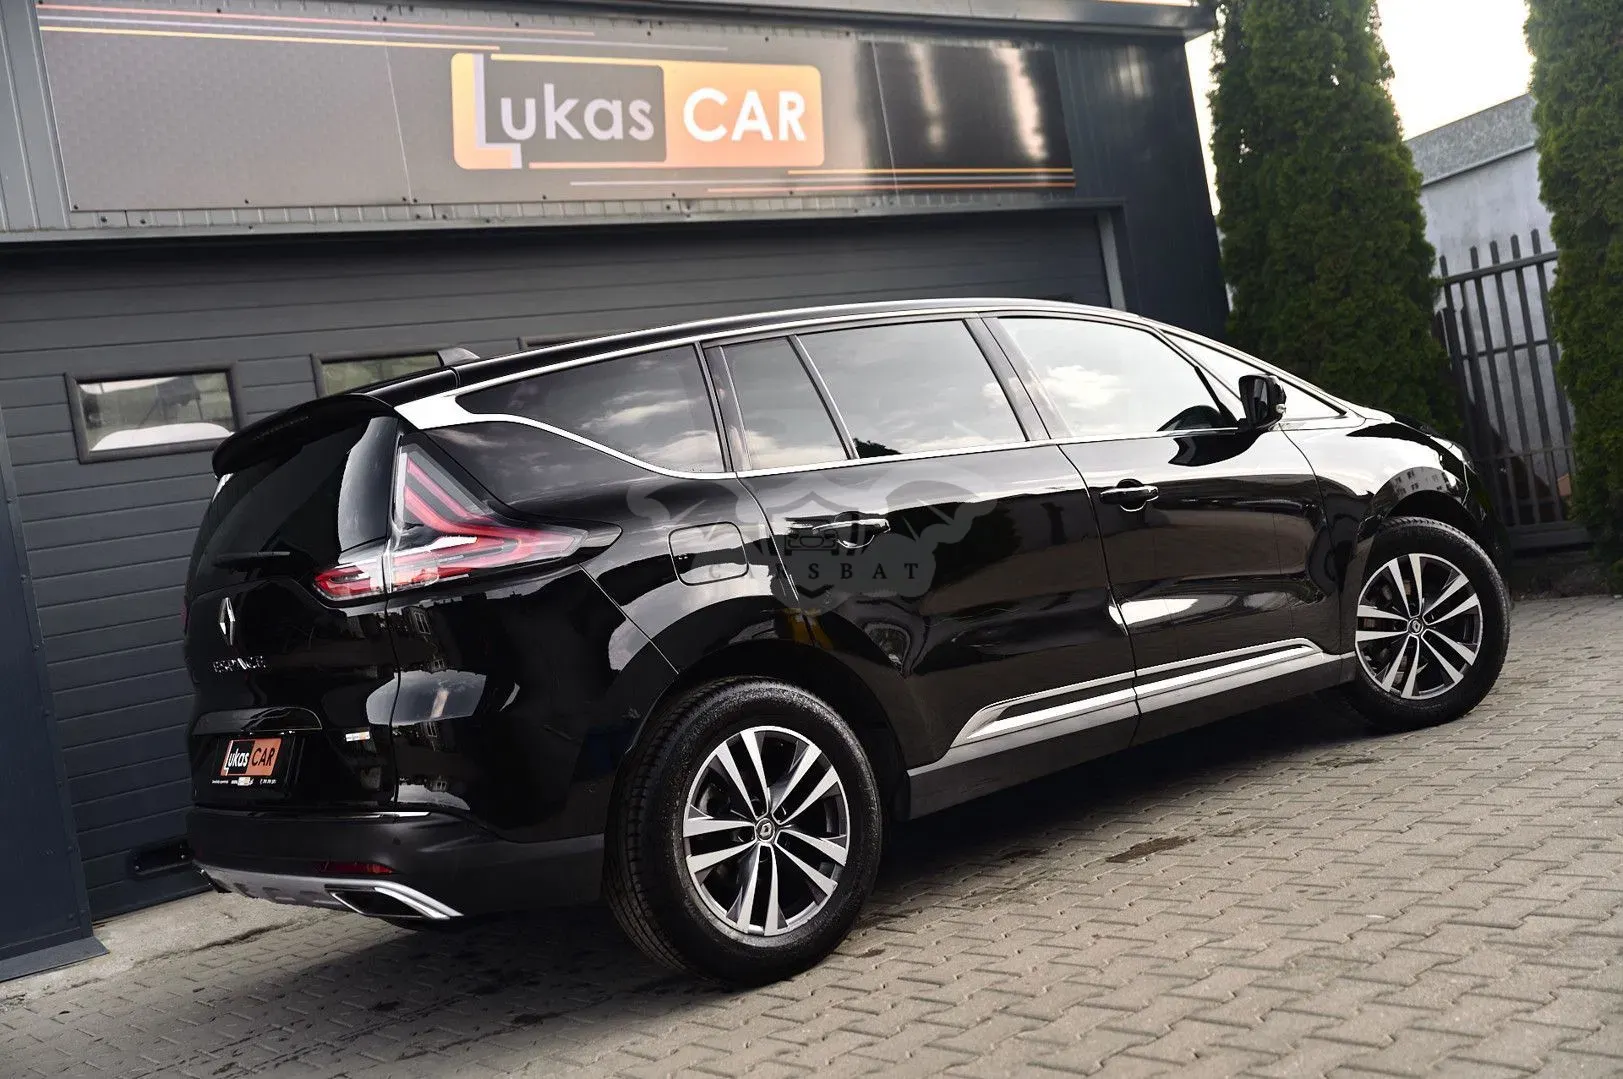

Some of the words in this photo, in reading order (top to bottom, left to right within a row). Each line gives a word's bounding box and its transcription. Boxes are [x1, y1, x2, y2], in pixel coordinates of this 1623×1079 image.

[474, 53, 655, 169] Lukas
[683, 88, 806, 142] CAR
[223, 740, 250, 776] Lukas
[251, 747, 276, 767] CAR
